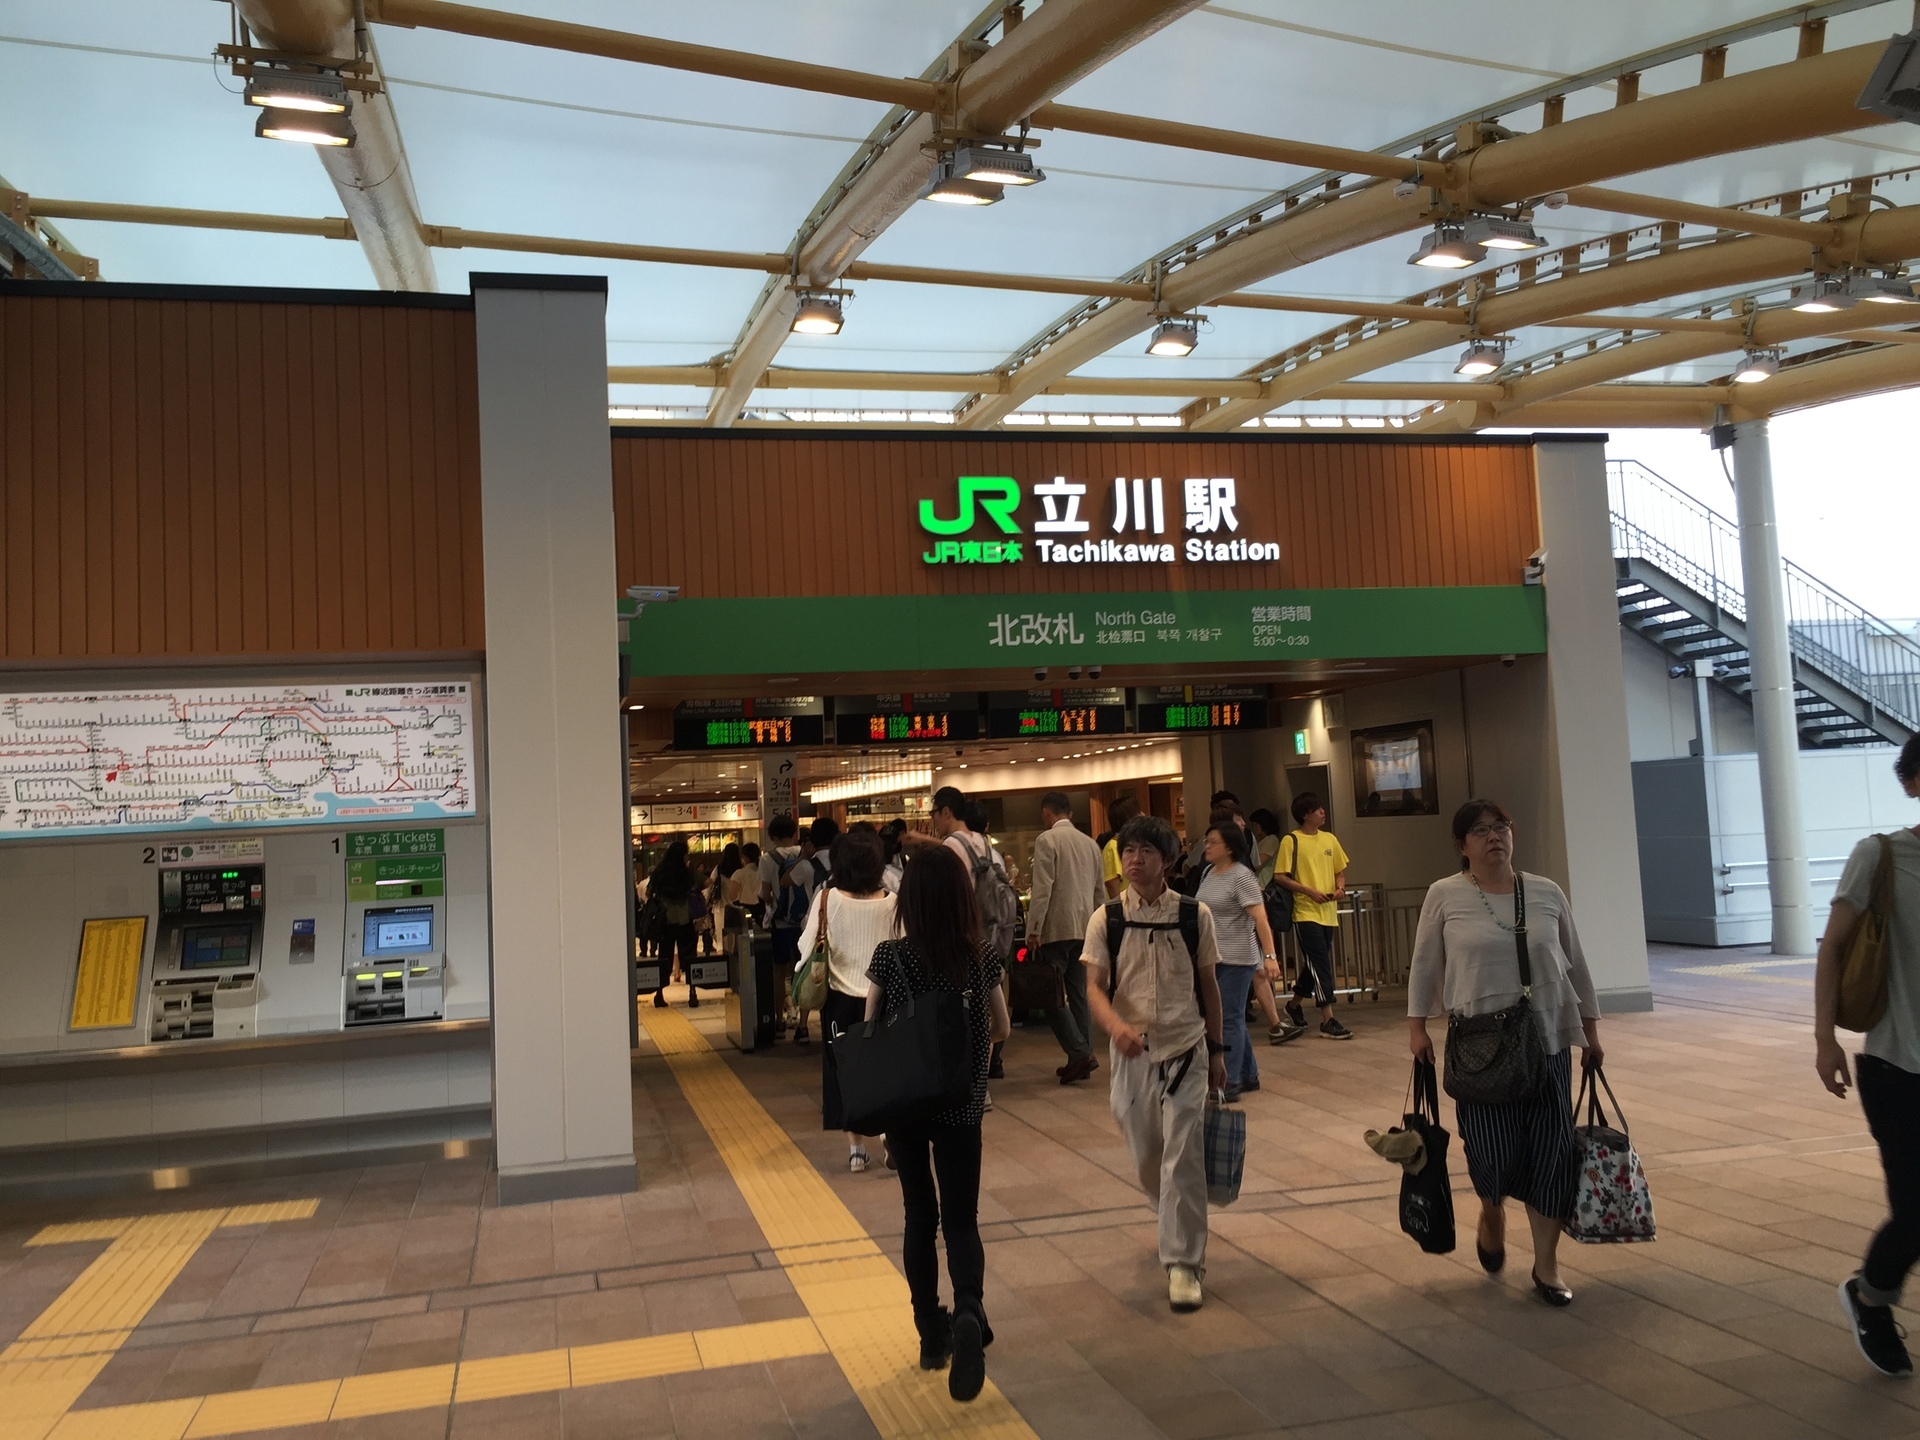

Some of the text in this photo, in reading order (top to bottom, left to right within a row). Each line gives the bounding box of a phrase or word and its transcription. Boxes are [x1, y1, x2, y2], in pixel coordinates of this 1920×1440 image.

[919, 476, 1023, 538] JR
[1033, 476, 1239, 537] 立川駅
[923, 540, 1023, 564] JR東日本
[1035, 538, 1280, 563] Tachikawa Station
[1095, 610, 1177, 626] North Gate
[1251, 606, 1312, 624] 営業時間
[988, 612, 1085, 646] 北改札
[1157, 628, 1223, 643] 북쪽 개찰구
[1252, 625, 1282, 636] OPEN
[1096, 630, 1146, 645] 北检票口
[332, 838, 339, 854] 1
[354, 831, 437, 846] きっぷ Tickets
[143, 847, 156, 864] 2
[185, 873, 217, 882] Suica
